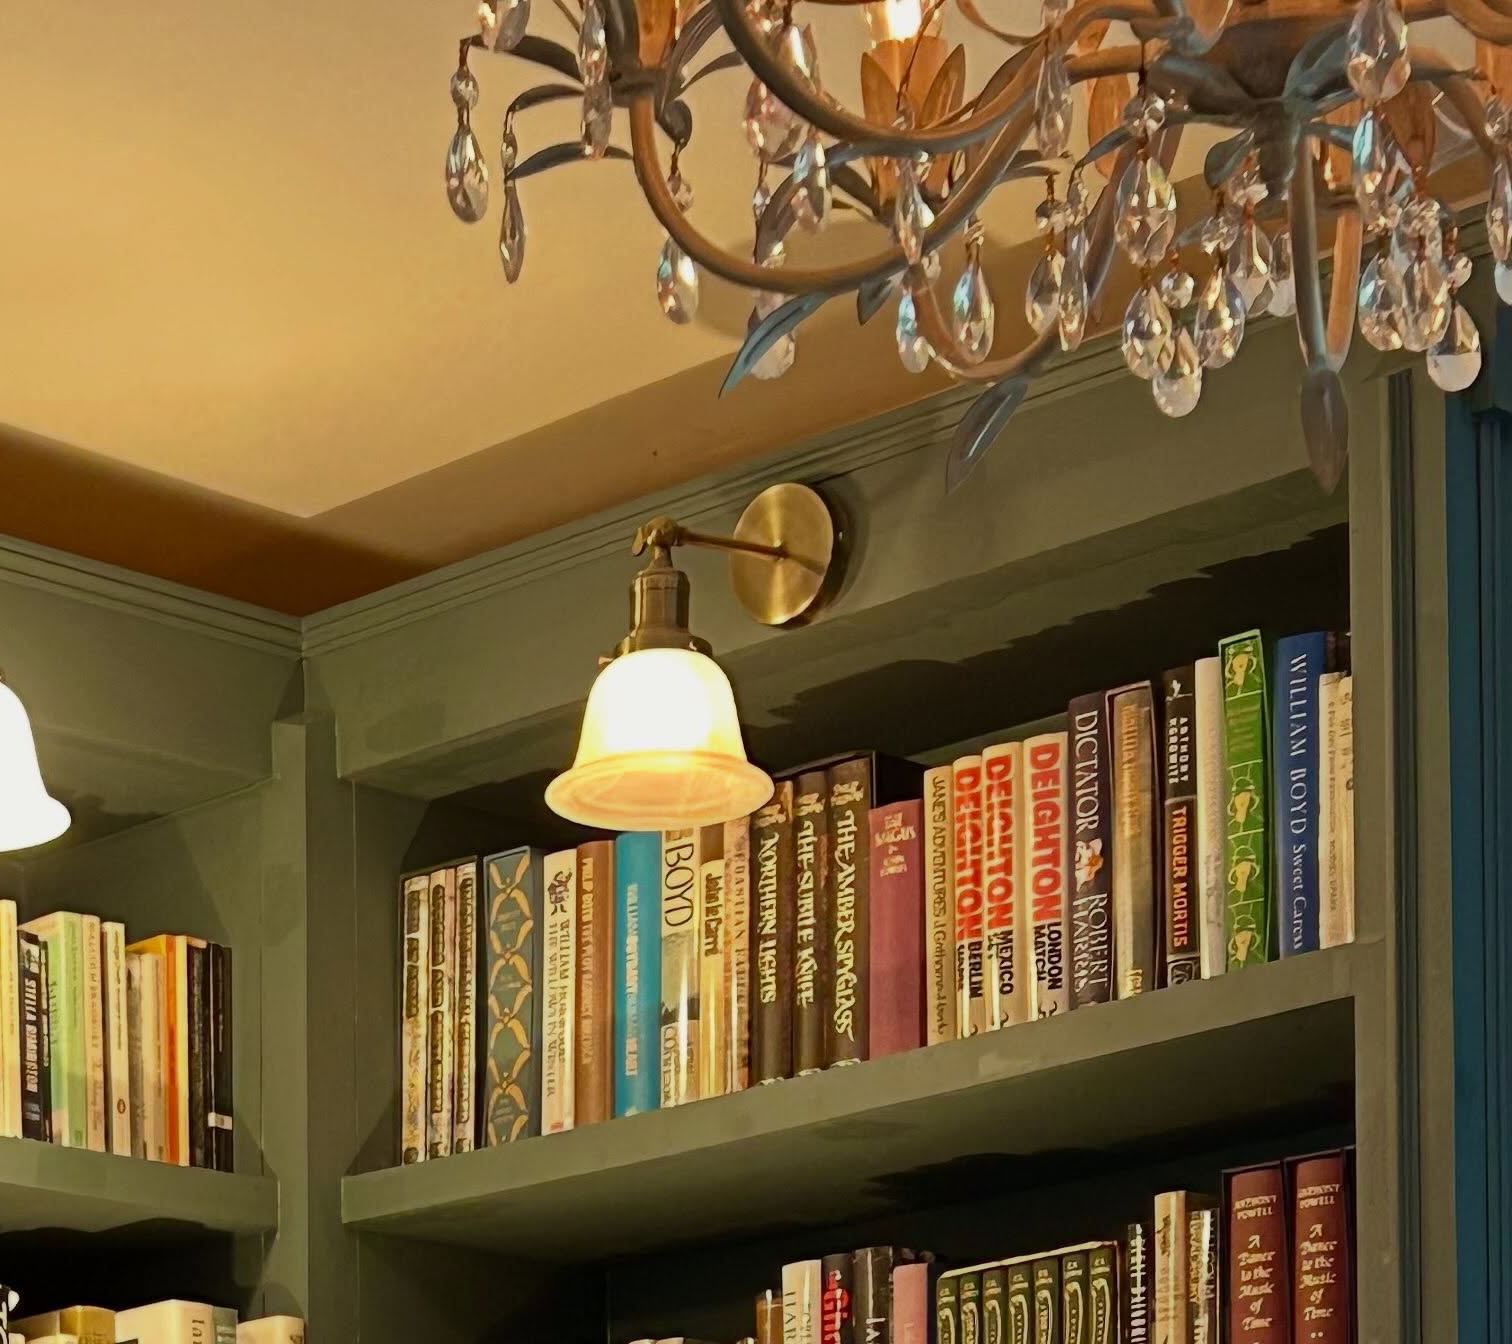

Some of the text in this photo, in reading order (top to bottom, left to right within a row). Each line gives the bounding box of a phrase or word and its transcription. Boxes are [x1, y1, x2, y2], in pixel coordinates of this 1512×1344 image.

[1029, 742, 1062, 922] DEIGHTON
[1074, 711, 1100, 831] DICTATOR
[1289, 653, 1308, 891] WILLIAM BOYD Sweet
[663, 844, 695, 928] BOYD
[834, 810, 857, 938] THE AMBER
[955, 768, 982, 942] DEIGHTON
[985, 754, 1014, 930] DEIGHTON
[1172, 805, 1189, 948] TRIGGER MORTIS
[758, 832, 779, 1004] NORTHERN LIGHTS
[967, 941, 983, 998] BERLIN
[997, 930, 1015, 996] MEXICO
[1046, 922, 1063, 991] LONDON
[1088, 893, 1109, 989] ROBERT
[23, 977, 39, 1022] STELLA
